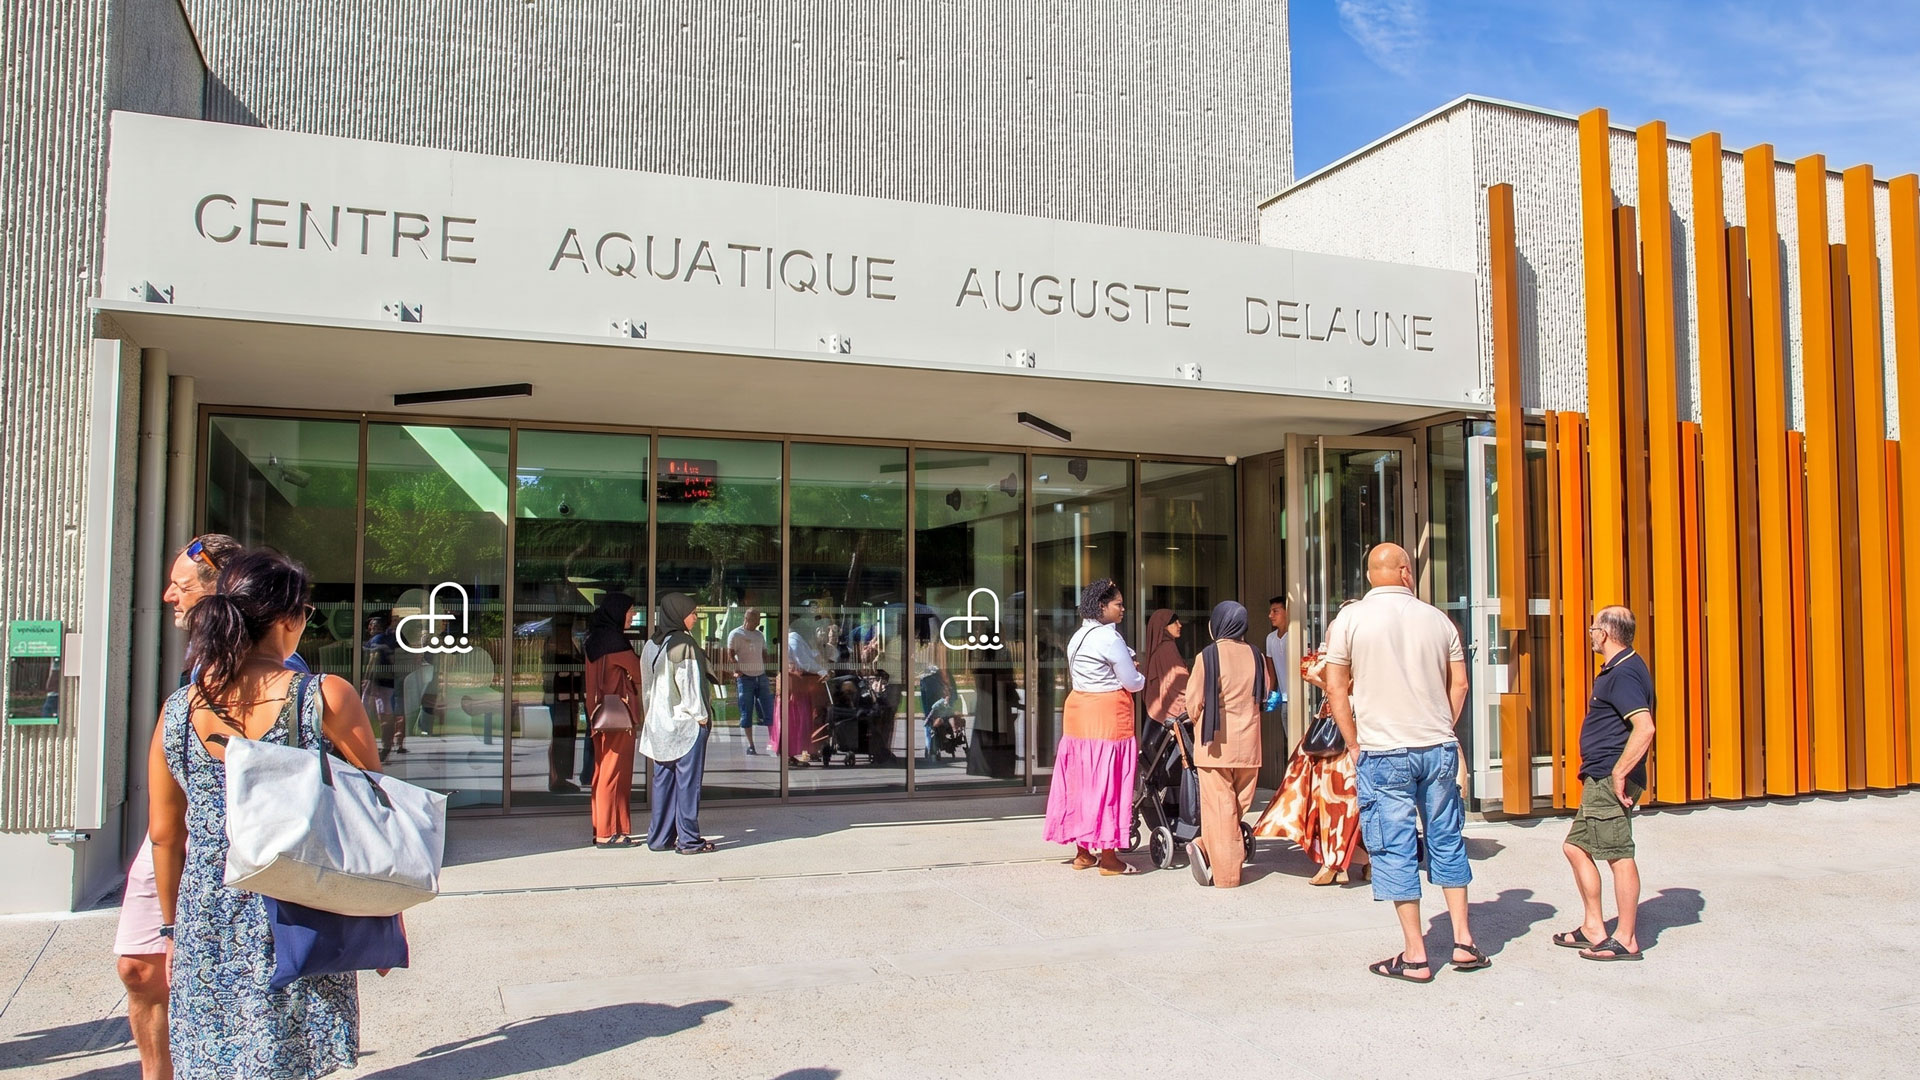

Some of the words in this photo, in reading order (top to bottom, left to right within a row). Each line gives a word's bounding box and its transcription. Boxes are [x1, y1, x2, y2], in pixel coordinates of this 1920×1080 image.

[194, 193, 478, 264] CENTRE
[548, 227, 897, 300] AQUATIQUE
[955, 267, 1192, 328] AUGUSTE
[1246, 296, 1436, 352] DELAUNE
